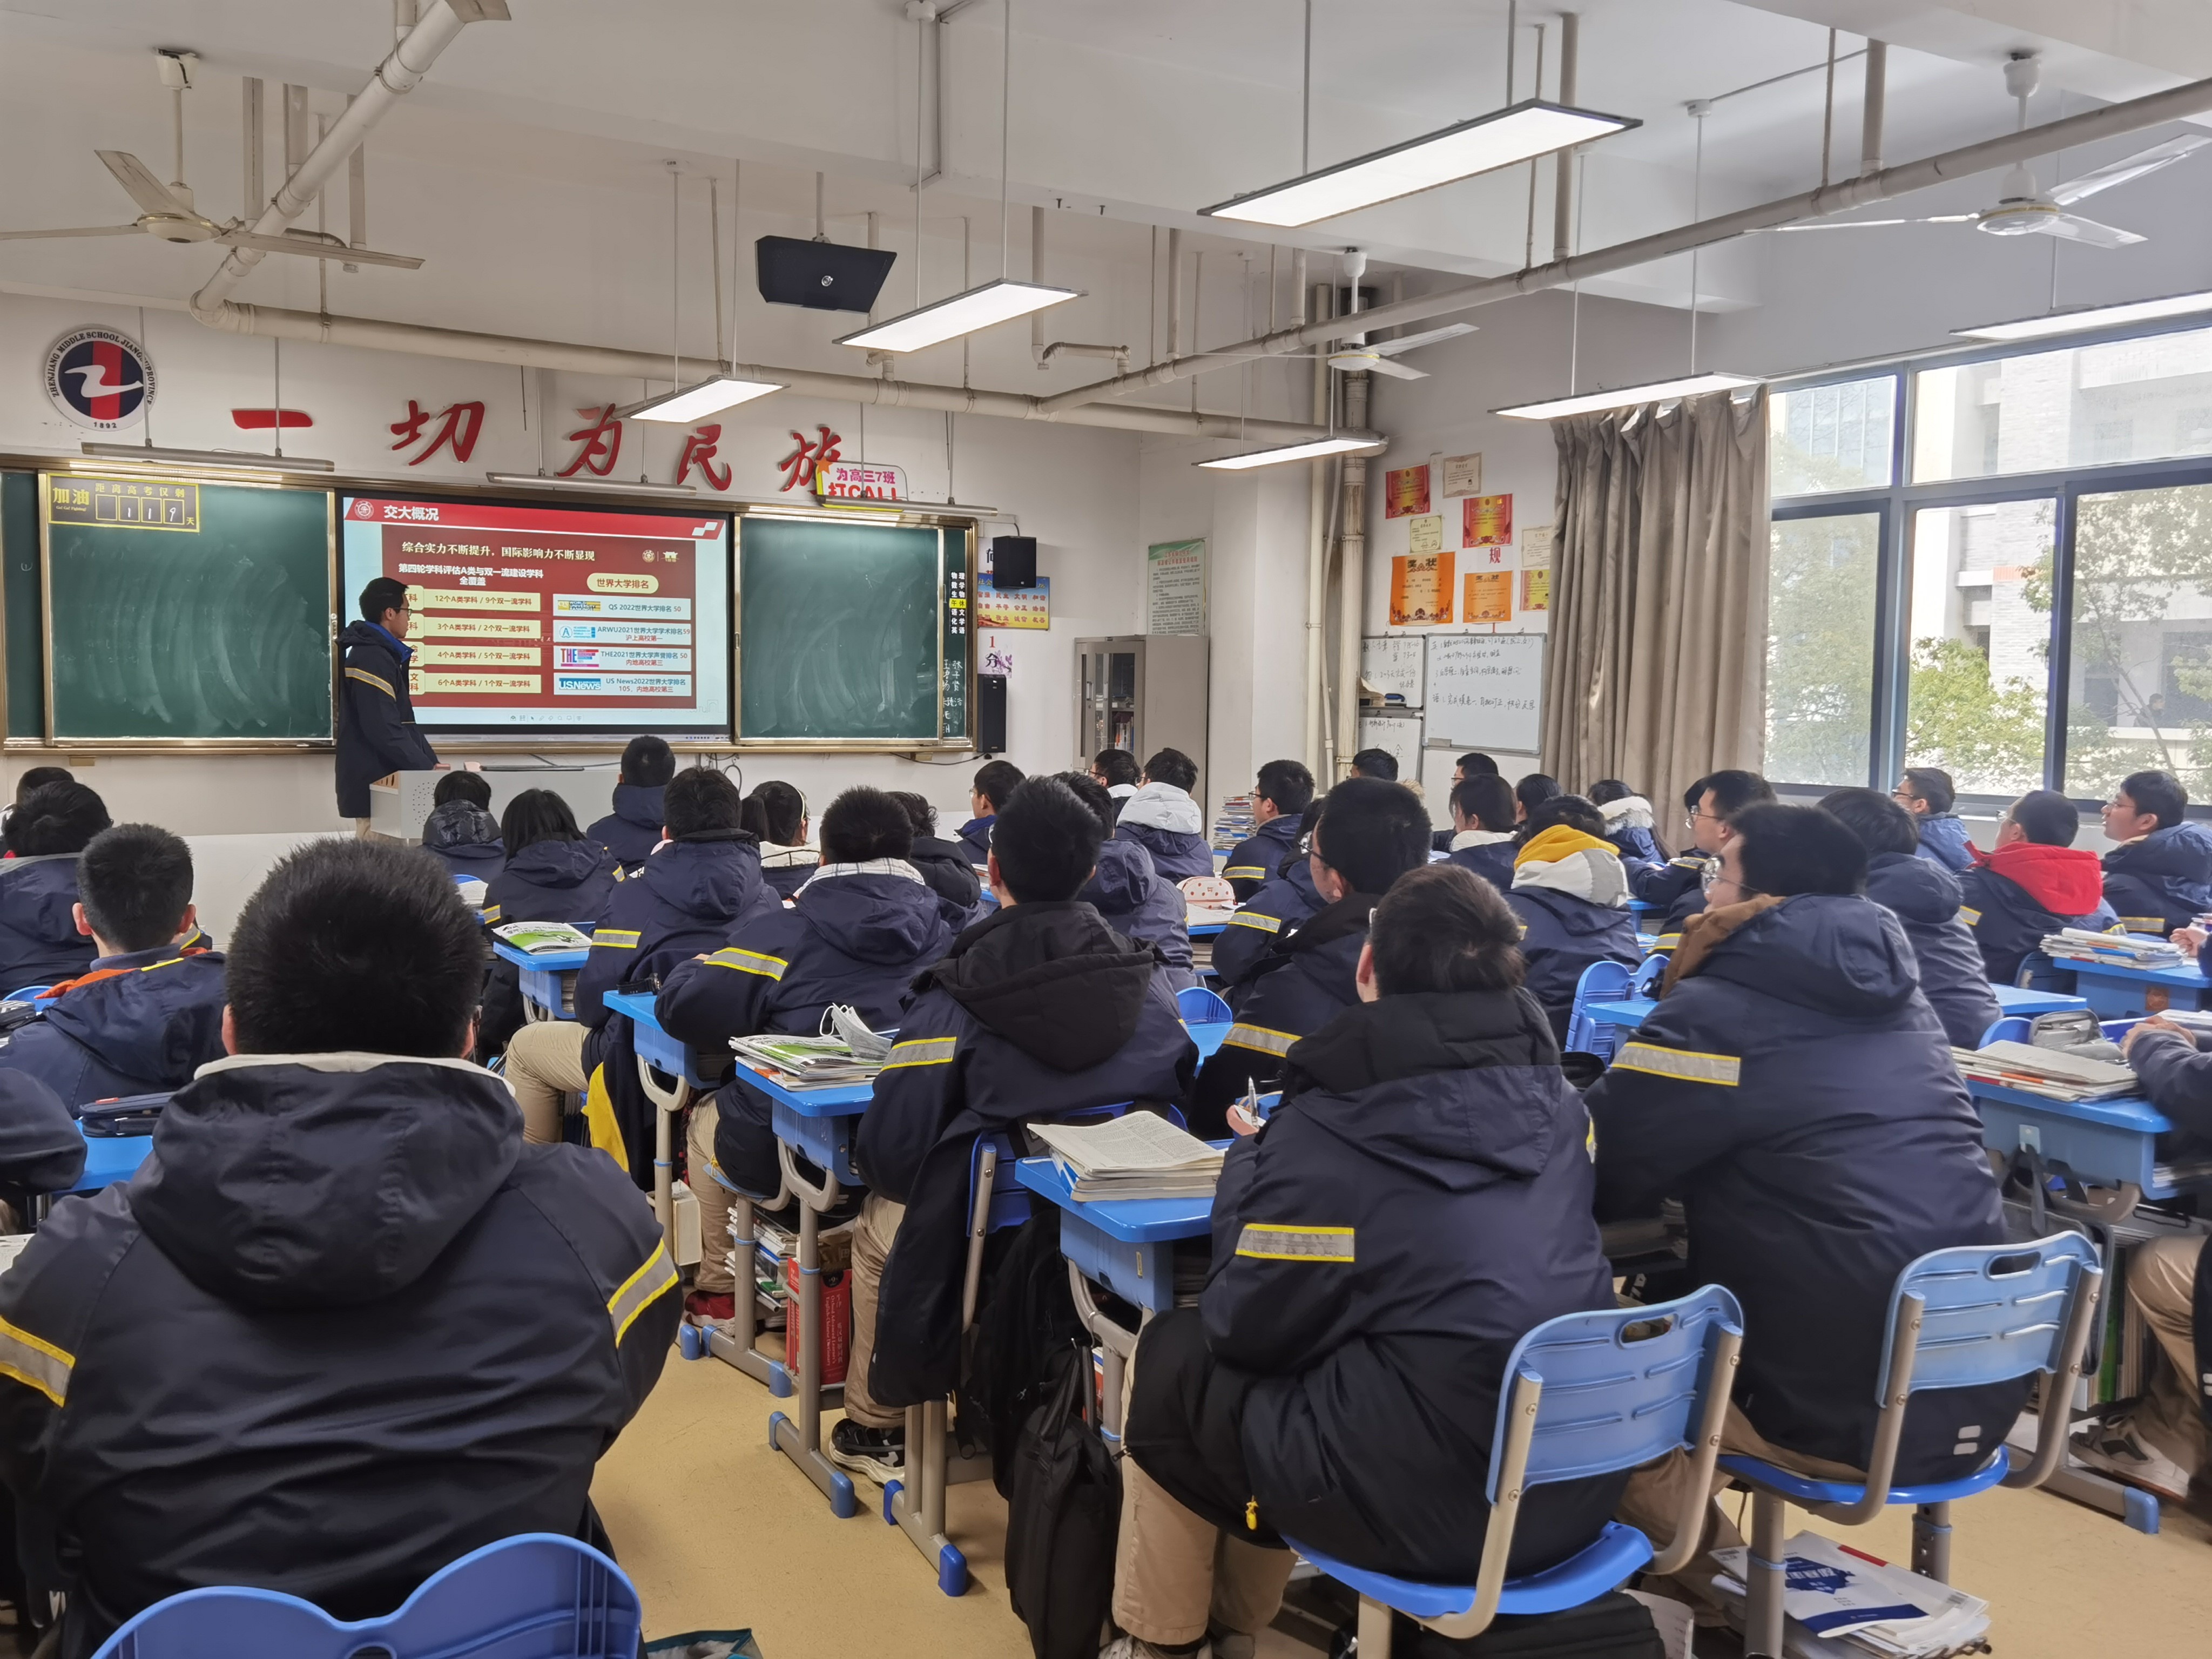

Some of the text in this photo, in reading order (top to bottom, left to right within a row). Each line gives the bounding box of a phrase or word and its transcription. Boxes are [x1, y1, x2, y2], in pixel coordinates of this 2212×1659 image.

[48, 353, 60, 397] ZHENJIANG
[57, 333, 85, 353] MIDDLE
[86, 331, 120, 342] SCHOOL
[836, 468, 895, 484] 为高三7班
[53, 488, 90, 505] 加油
[95, 483, 185, 498] 距离高考仅剩
[383, 505, 440, 521] 交大概况
[186, 517, 195, 525] 天
[1489, 547, 1501, 564] 规
[399, 563, 544, 579] 第四轮学科评估A类与双一流建设学科
[951, 572, 965, 580] 物理
[459, 576, 486, 586] 全覆盖
[596, 578, 649, 589] 世界大学排名
[951, 590, 965, 598] 生物
[951, 617, 965, 625] 化学
[951, 626, 965, 635] 英语
[561, 649, 577, 663] THE
